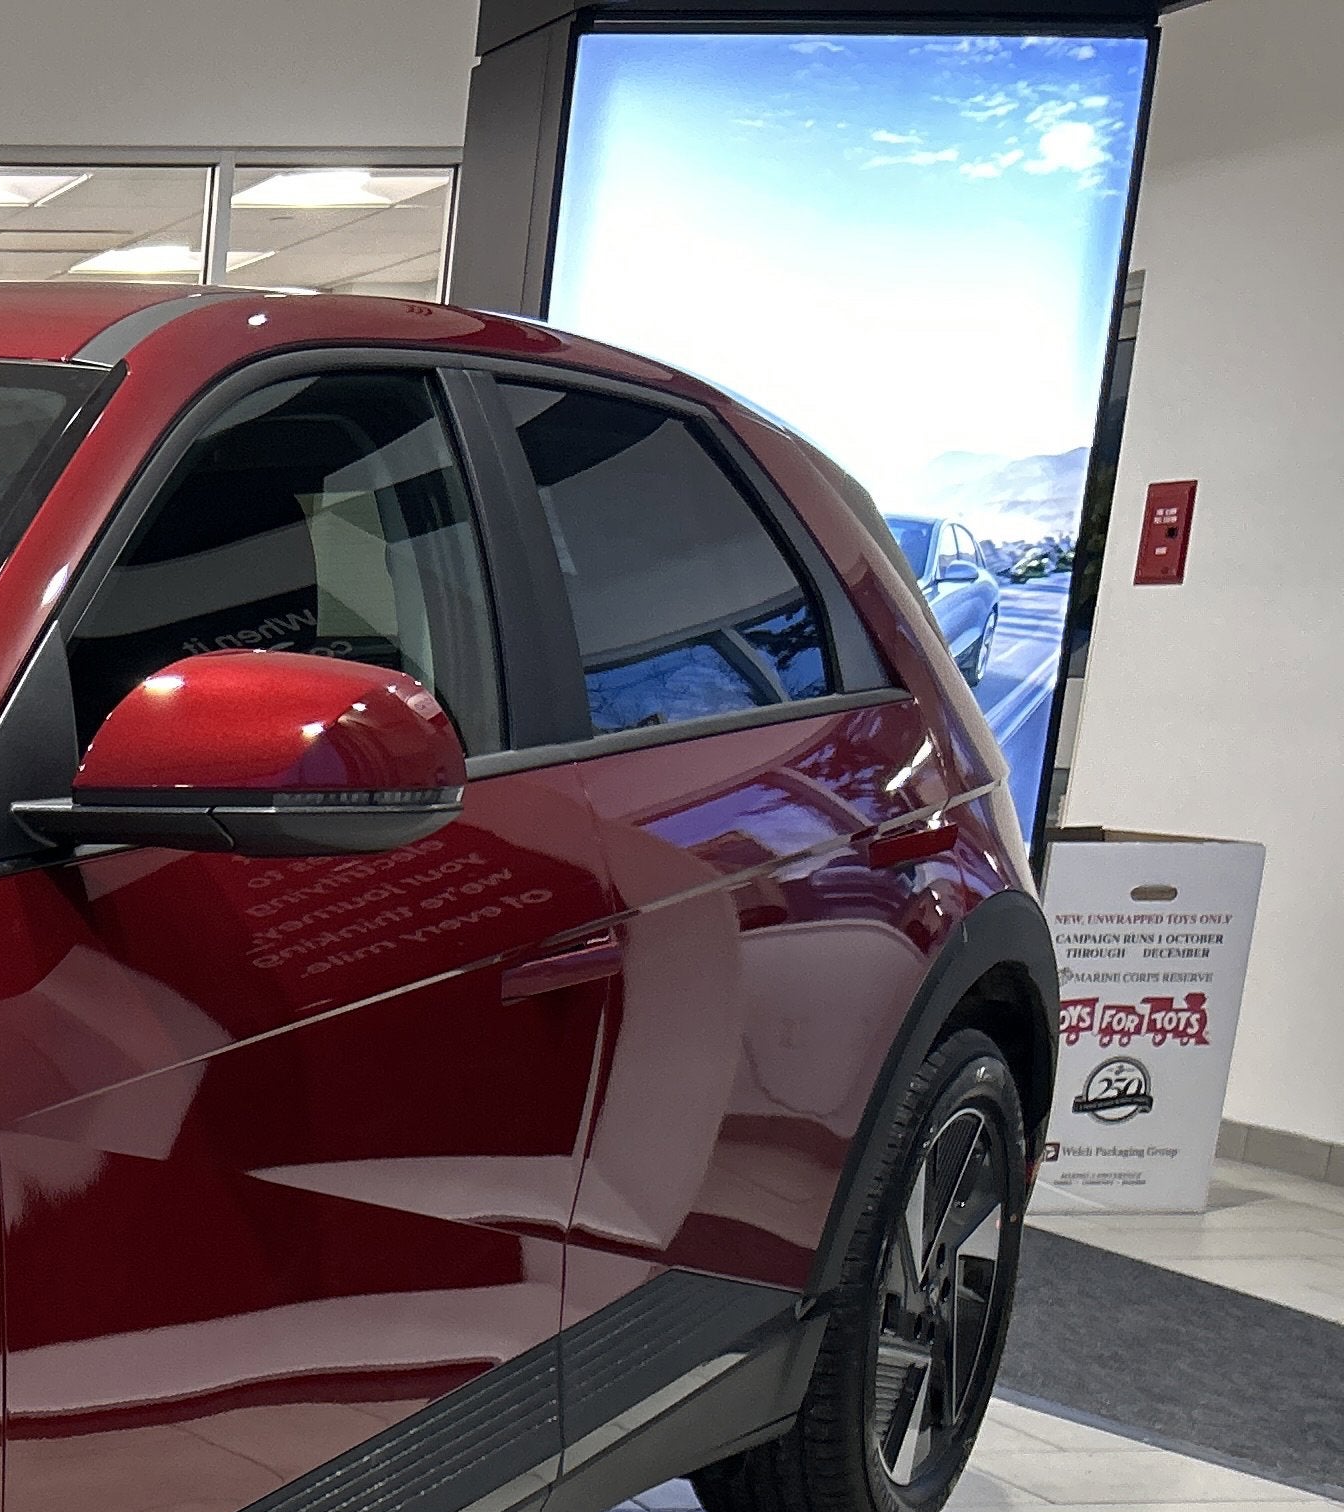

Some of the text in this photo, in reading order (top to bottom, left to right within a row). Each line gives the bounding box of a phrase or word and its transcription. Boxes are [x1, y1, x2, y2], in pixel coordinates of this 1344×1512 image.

[1166, 914, 1197, 925] TOYS
[1199, 914, 1233, 925] ONLY
[1055, 934, 1121, 945] CAMPAIGN
[1123, 934, 1155, 945] RUNS
[1165, 934, 1224, 945] OCTOBER
[1066, 948, 1211, 959] THROUGH DECEMBER
[1074, 973, 1213, 983] MARINE CORPS RESERVE
[1060, 1004, 1201, 1036] OYS FOR TOTS
[1096, 1076, 1143, 1099] 250
[1096, 1146, 1145, 1158] Packaging
